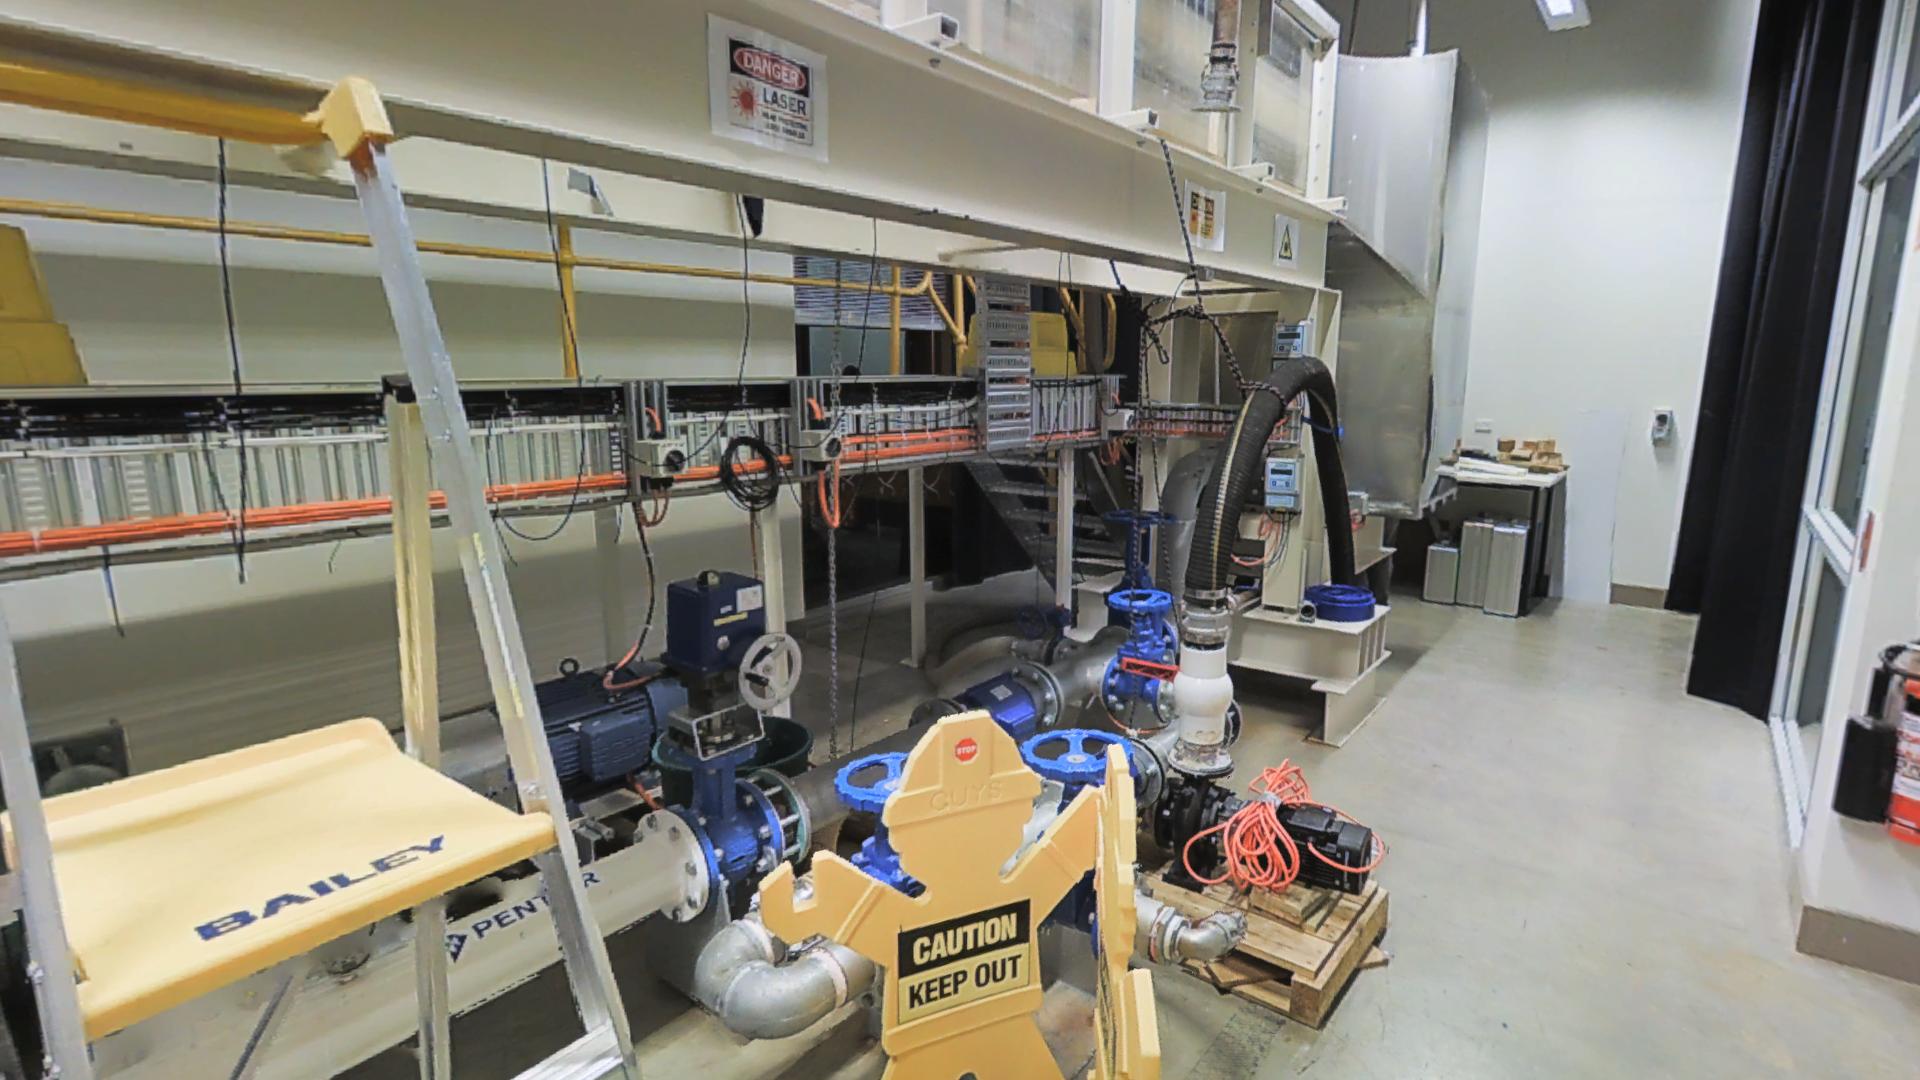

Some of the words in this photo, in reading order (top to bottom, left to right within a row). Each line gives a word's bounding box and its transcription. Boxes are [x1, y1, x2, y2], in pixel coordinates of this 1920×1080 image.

[743, 51, 799, 87] DANGER
[763, 87, 807, 116] LASER
[957, 745, 977, 756] STOP
[194, 835, 445, 941] BAILEY
[472, 872, 600, 939] PENTR
[913, 913, 1018, 965] CAUTION
[909, 969, 968, 1009] KEEP
[975, 955, 1022, 988] OUT
